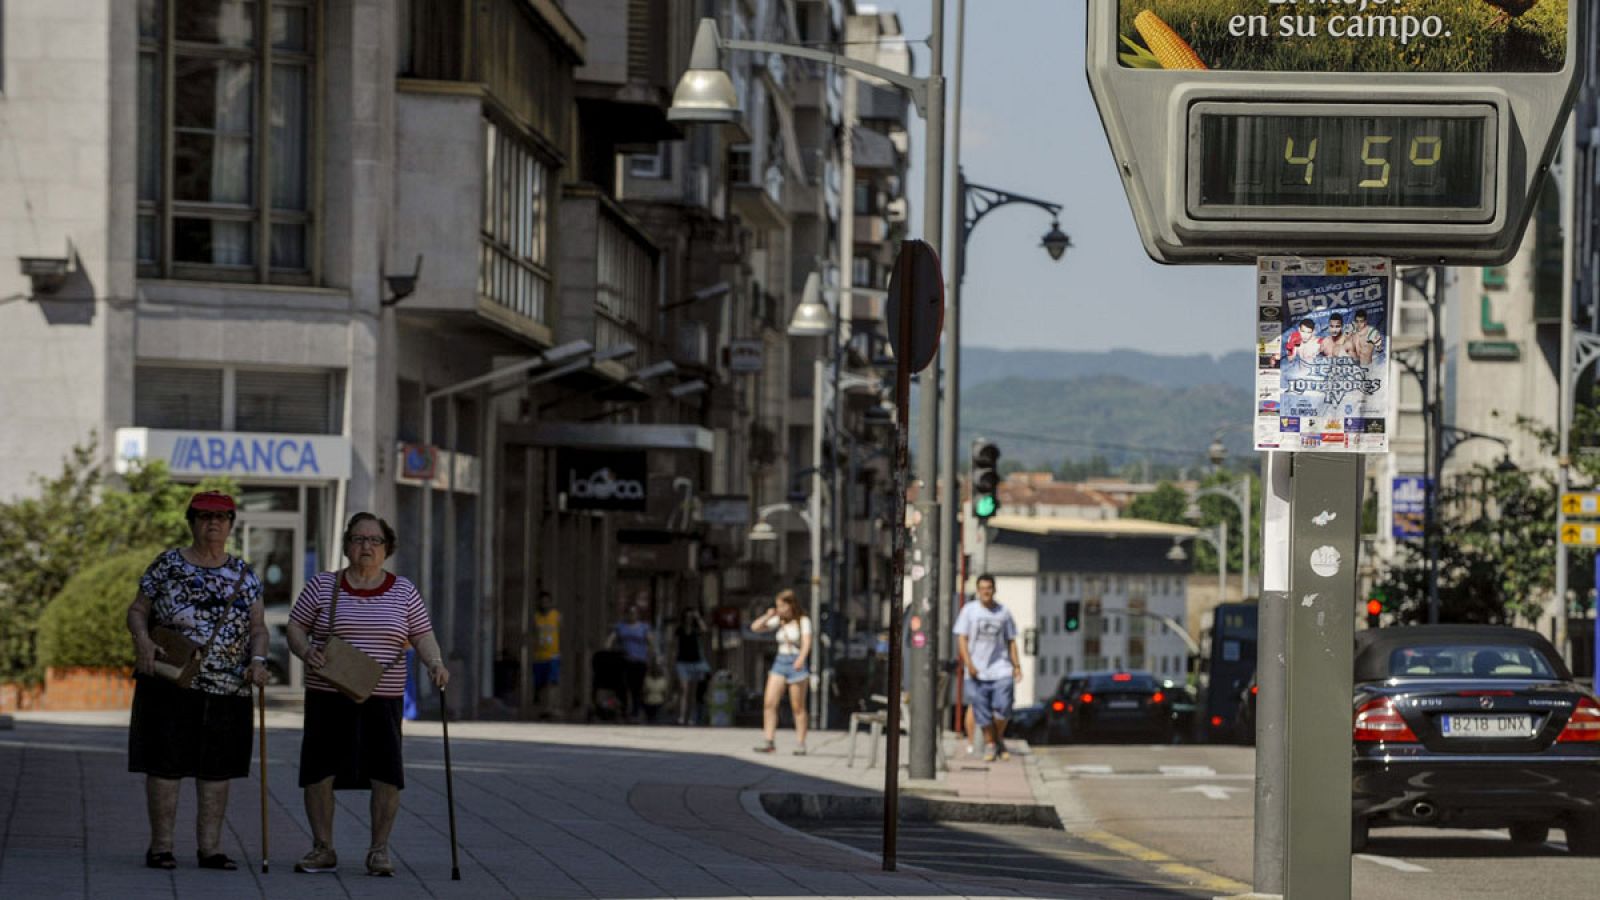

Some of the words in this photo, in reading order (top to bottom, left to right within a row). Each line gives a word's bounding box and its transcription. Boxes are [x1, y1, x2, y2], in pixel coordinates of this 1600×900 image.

[1228, 15, 1269, 37] en
[1279, 15, 1317, 37] su
[1328, 15, 1452, 45] campo.
[1287, 283, 1382, 316] BOXEO
[183, 436, 320, 474] ABANCA
[1453, 714, 1489, 732] 8218
[1498, 714, 1526, 731] DNX
